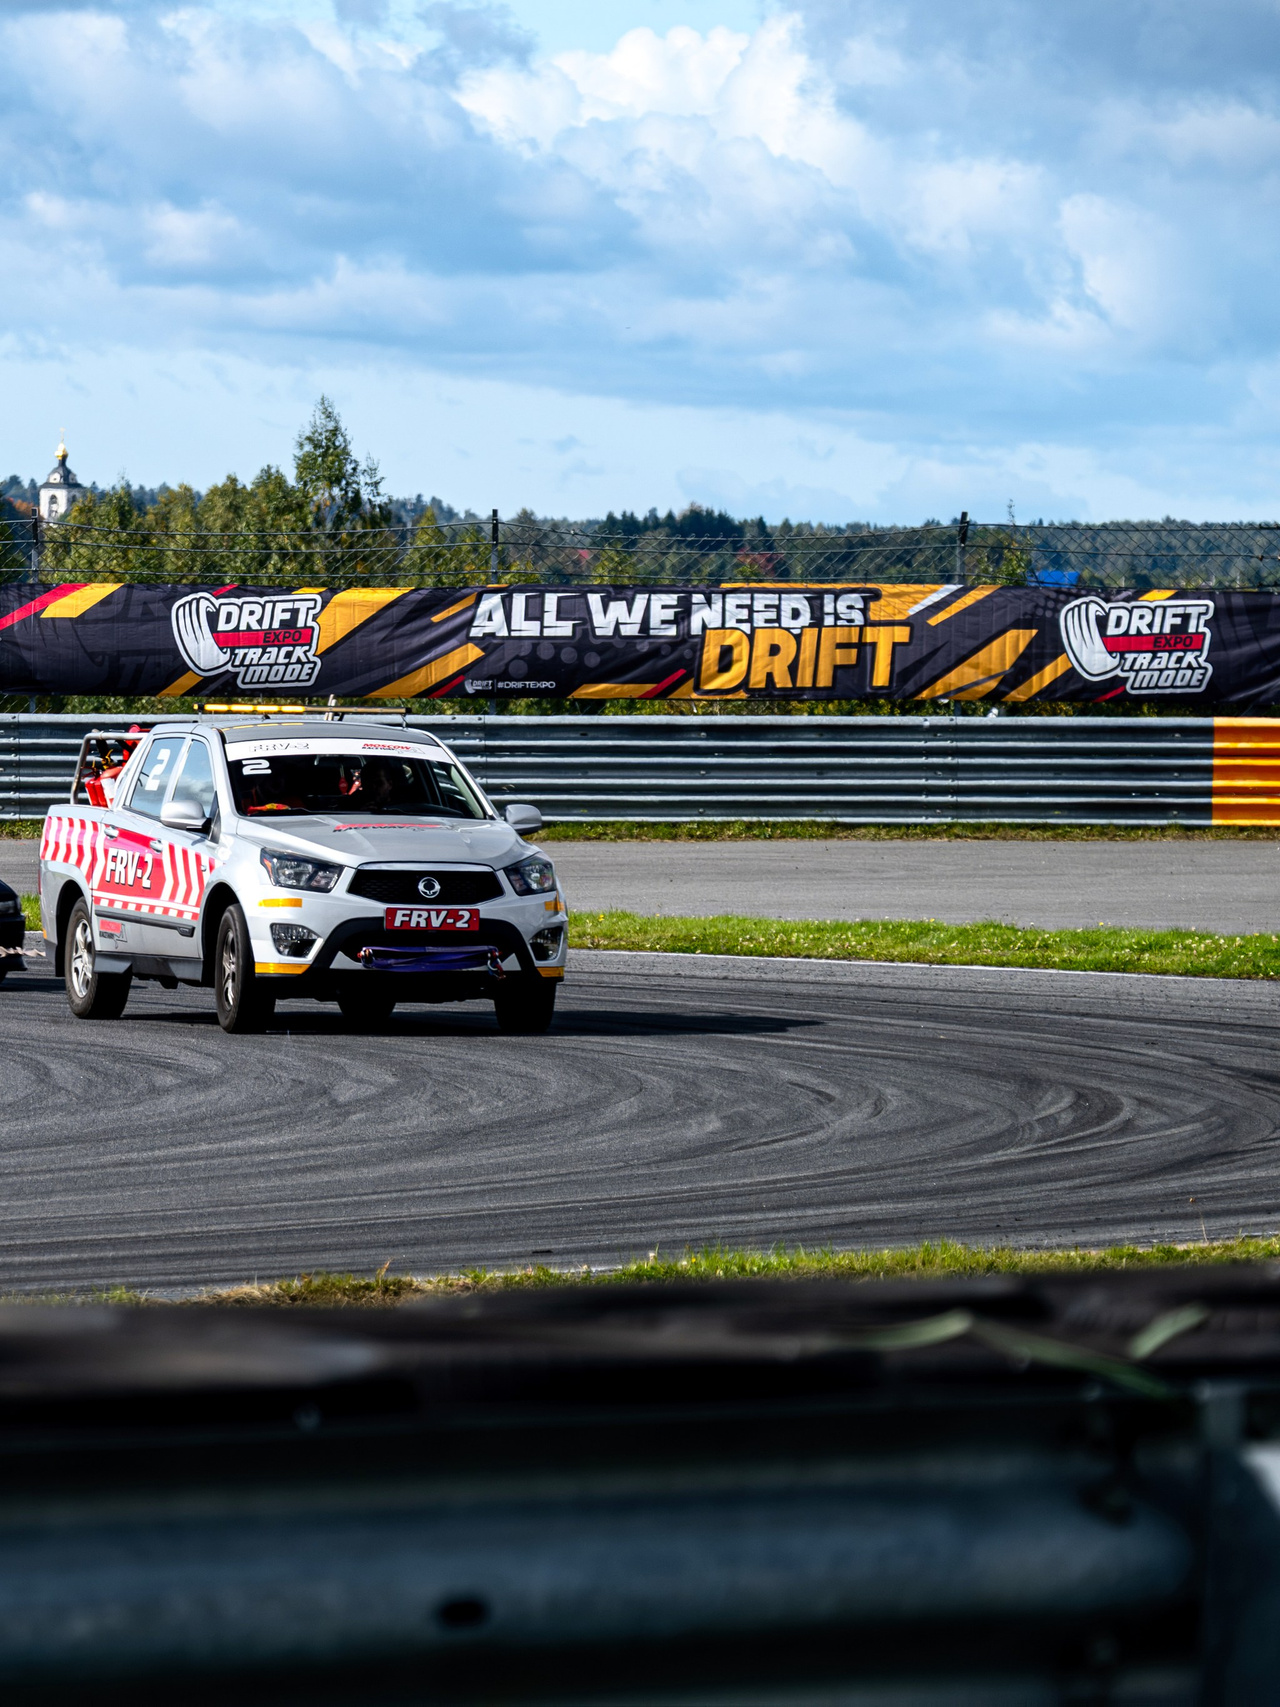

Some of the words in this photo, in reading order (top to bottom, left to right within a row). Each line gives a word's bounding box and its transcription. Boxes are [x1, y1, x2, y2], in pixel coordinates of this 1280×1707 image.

[217, 600, 316, 631] DRIFT
[469, 593, 582, 637] ALL
[586, 593, 685, 636] WE
[691, 593, 812, 635] NEED
[823, 593, 873, 626] IS
[1106, 606, 1207, 636] DRIFT
[263, 631, 302, 643] EXPO
[1153, 635, 1193, 648] EXPO
[233, 646, 310, 665] TRACK
[700, 626, 910, 690] DRIFT
[1123, 651, 1200, 670] TRACK
[244, 663, 315, 683] MODE
[1134, 669, 1205, 688] MODE
[497, 681, 556, 689] #DRIFTEXPO
[145, 749, 171, 791] 2
[242, 759, 272, 775] 2
[105, 847, 153, 889] FRV-2
[394, 910, 471, 928] FRV-2
